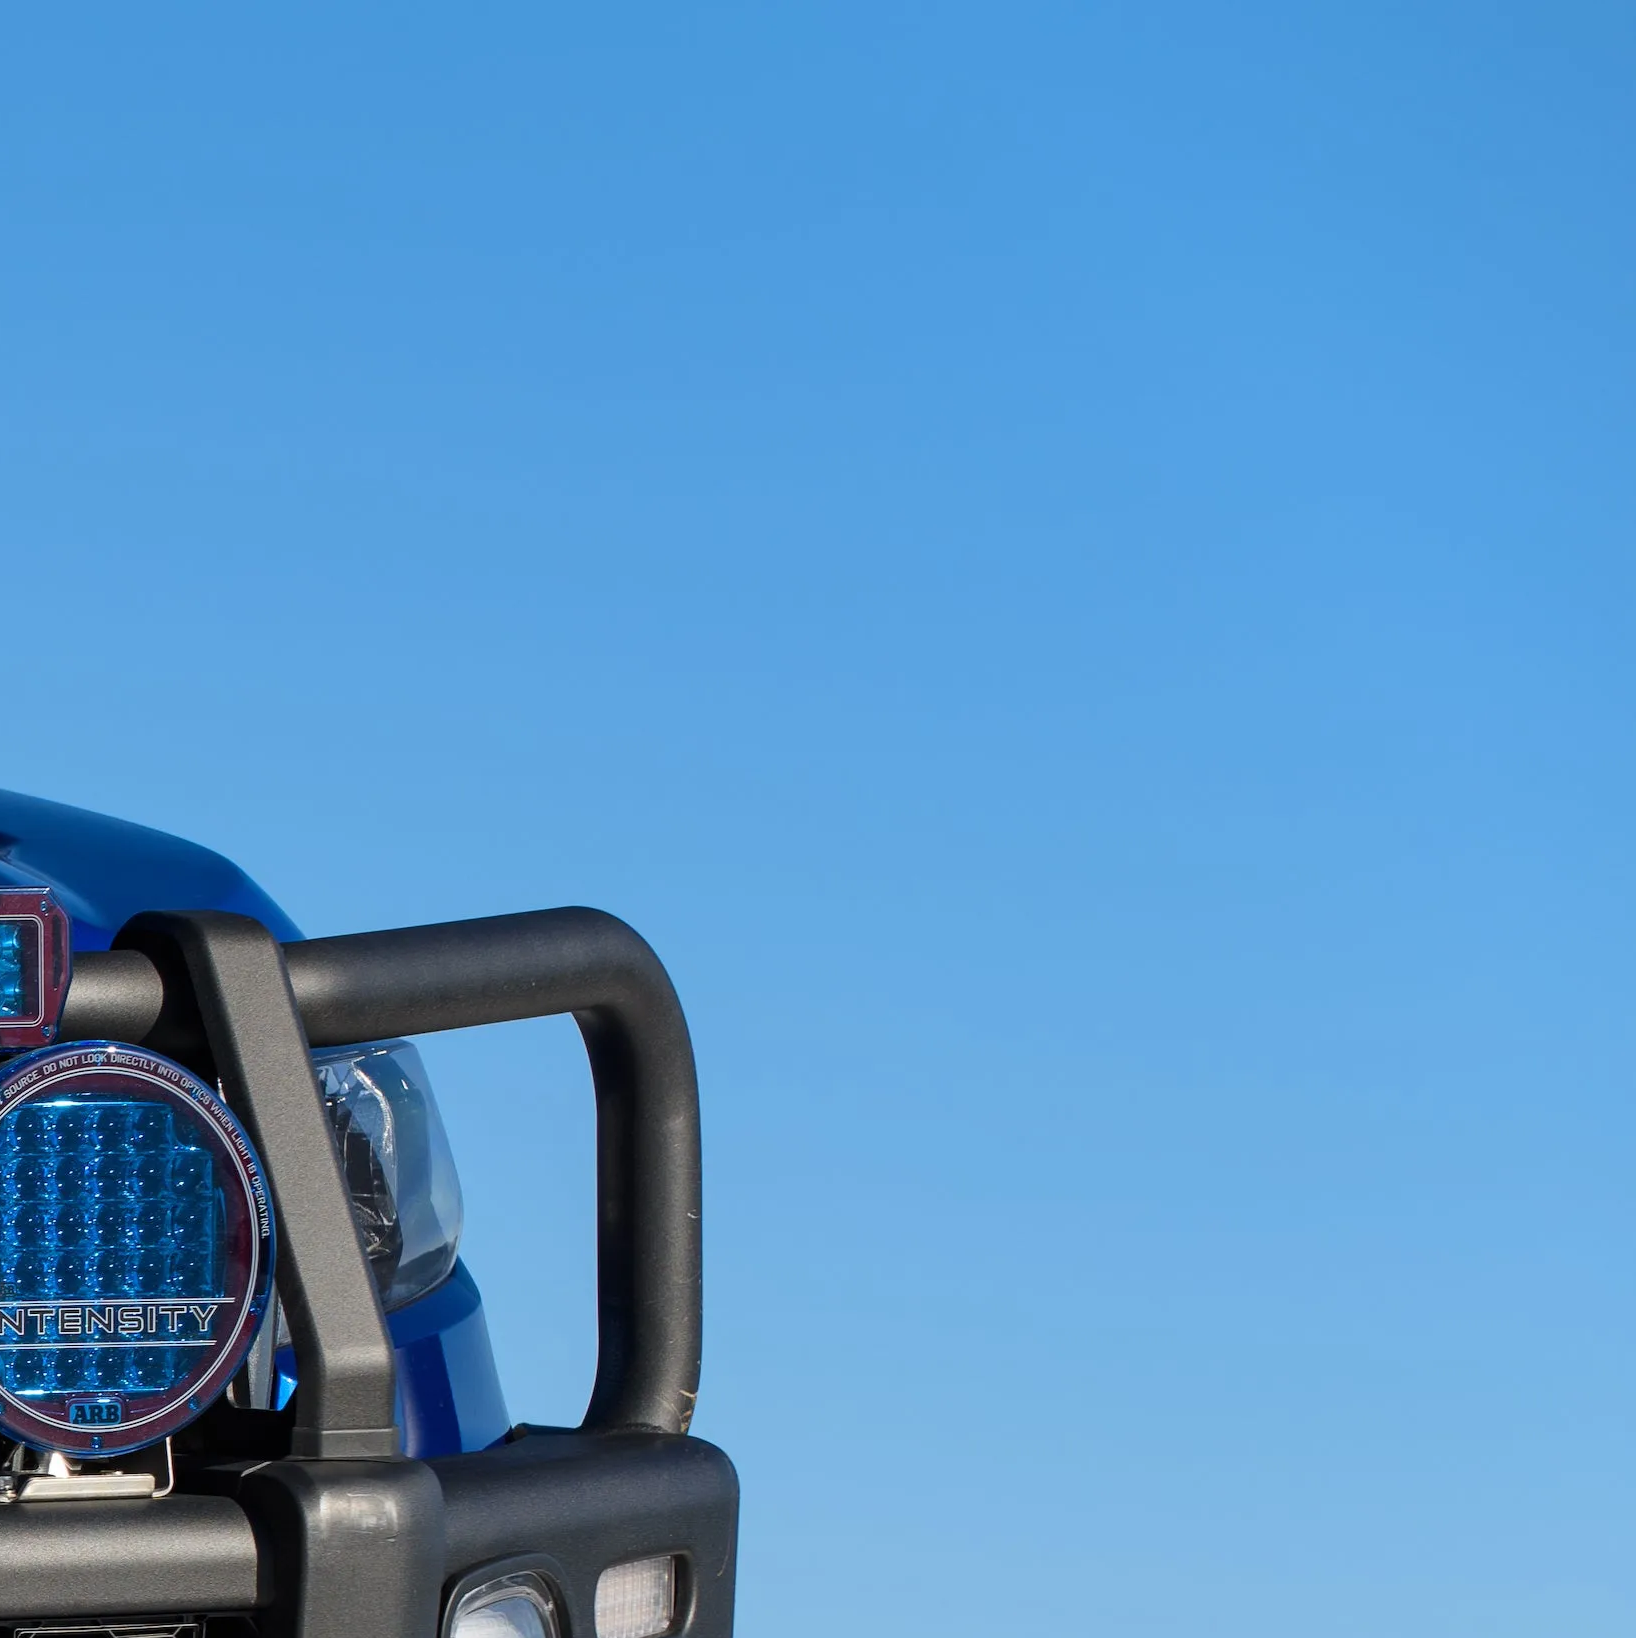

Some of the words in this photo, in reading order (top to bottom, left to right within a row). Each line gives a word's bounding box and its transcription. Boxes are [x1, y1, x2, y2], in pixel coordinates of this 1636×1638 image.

[58, 1055, 79, 1069] NOT
[81, 1052, 108, 1064] LOOK
[110, 1053, 157, 1071] DIRECTLY
[43, 1062, 57, 1075] DO
[157, 1065, 180, 1082] INTO
[180, 1077, 211, 1106] OPTICS
[210, 1102, 234, 1132] WHEN
[231, 1131, 252, 1161] LIGHT
[246, 1162, 257, 1175] IS
[251, 1174, 270, 1240] OPERATING.
[71, 1402, 121, 1424] ARB
